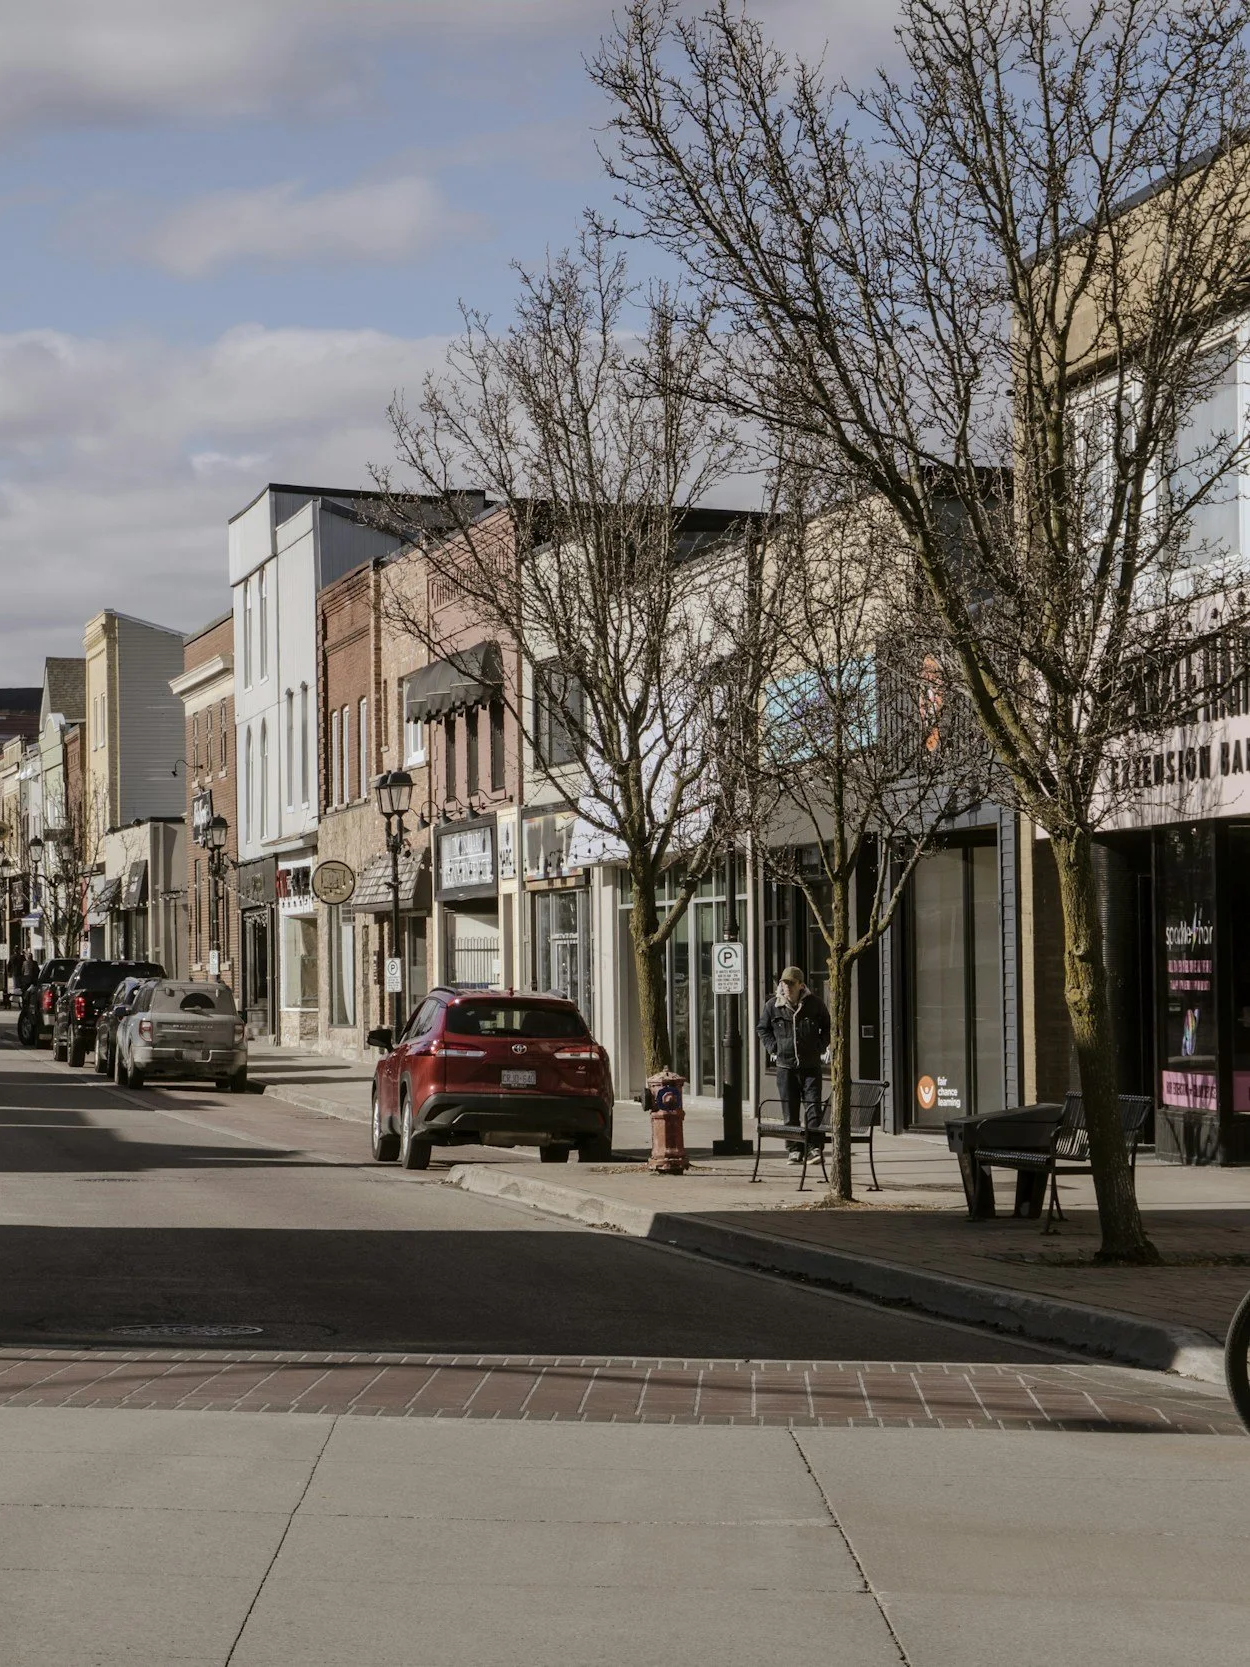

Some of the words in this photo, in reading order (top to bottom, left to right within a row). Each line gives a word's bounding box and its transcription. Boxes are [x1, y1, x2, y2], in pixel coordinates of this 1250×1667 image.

[1198, 920, 1214, 945] hair
[724, 952, 732, 963] P
[937, 1076, 948, 1086] fair
[937, 1087, 958, 1096] chance
[937, 1097, 961, 1108] learning
